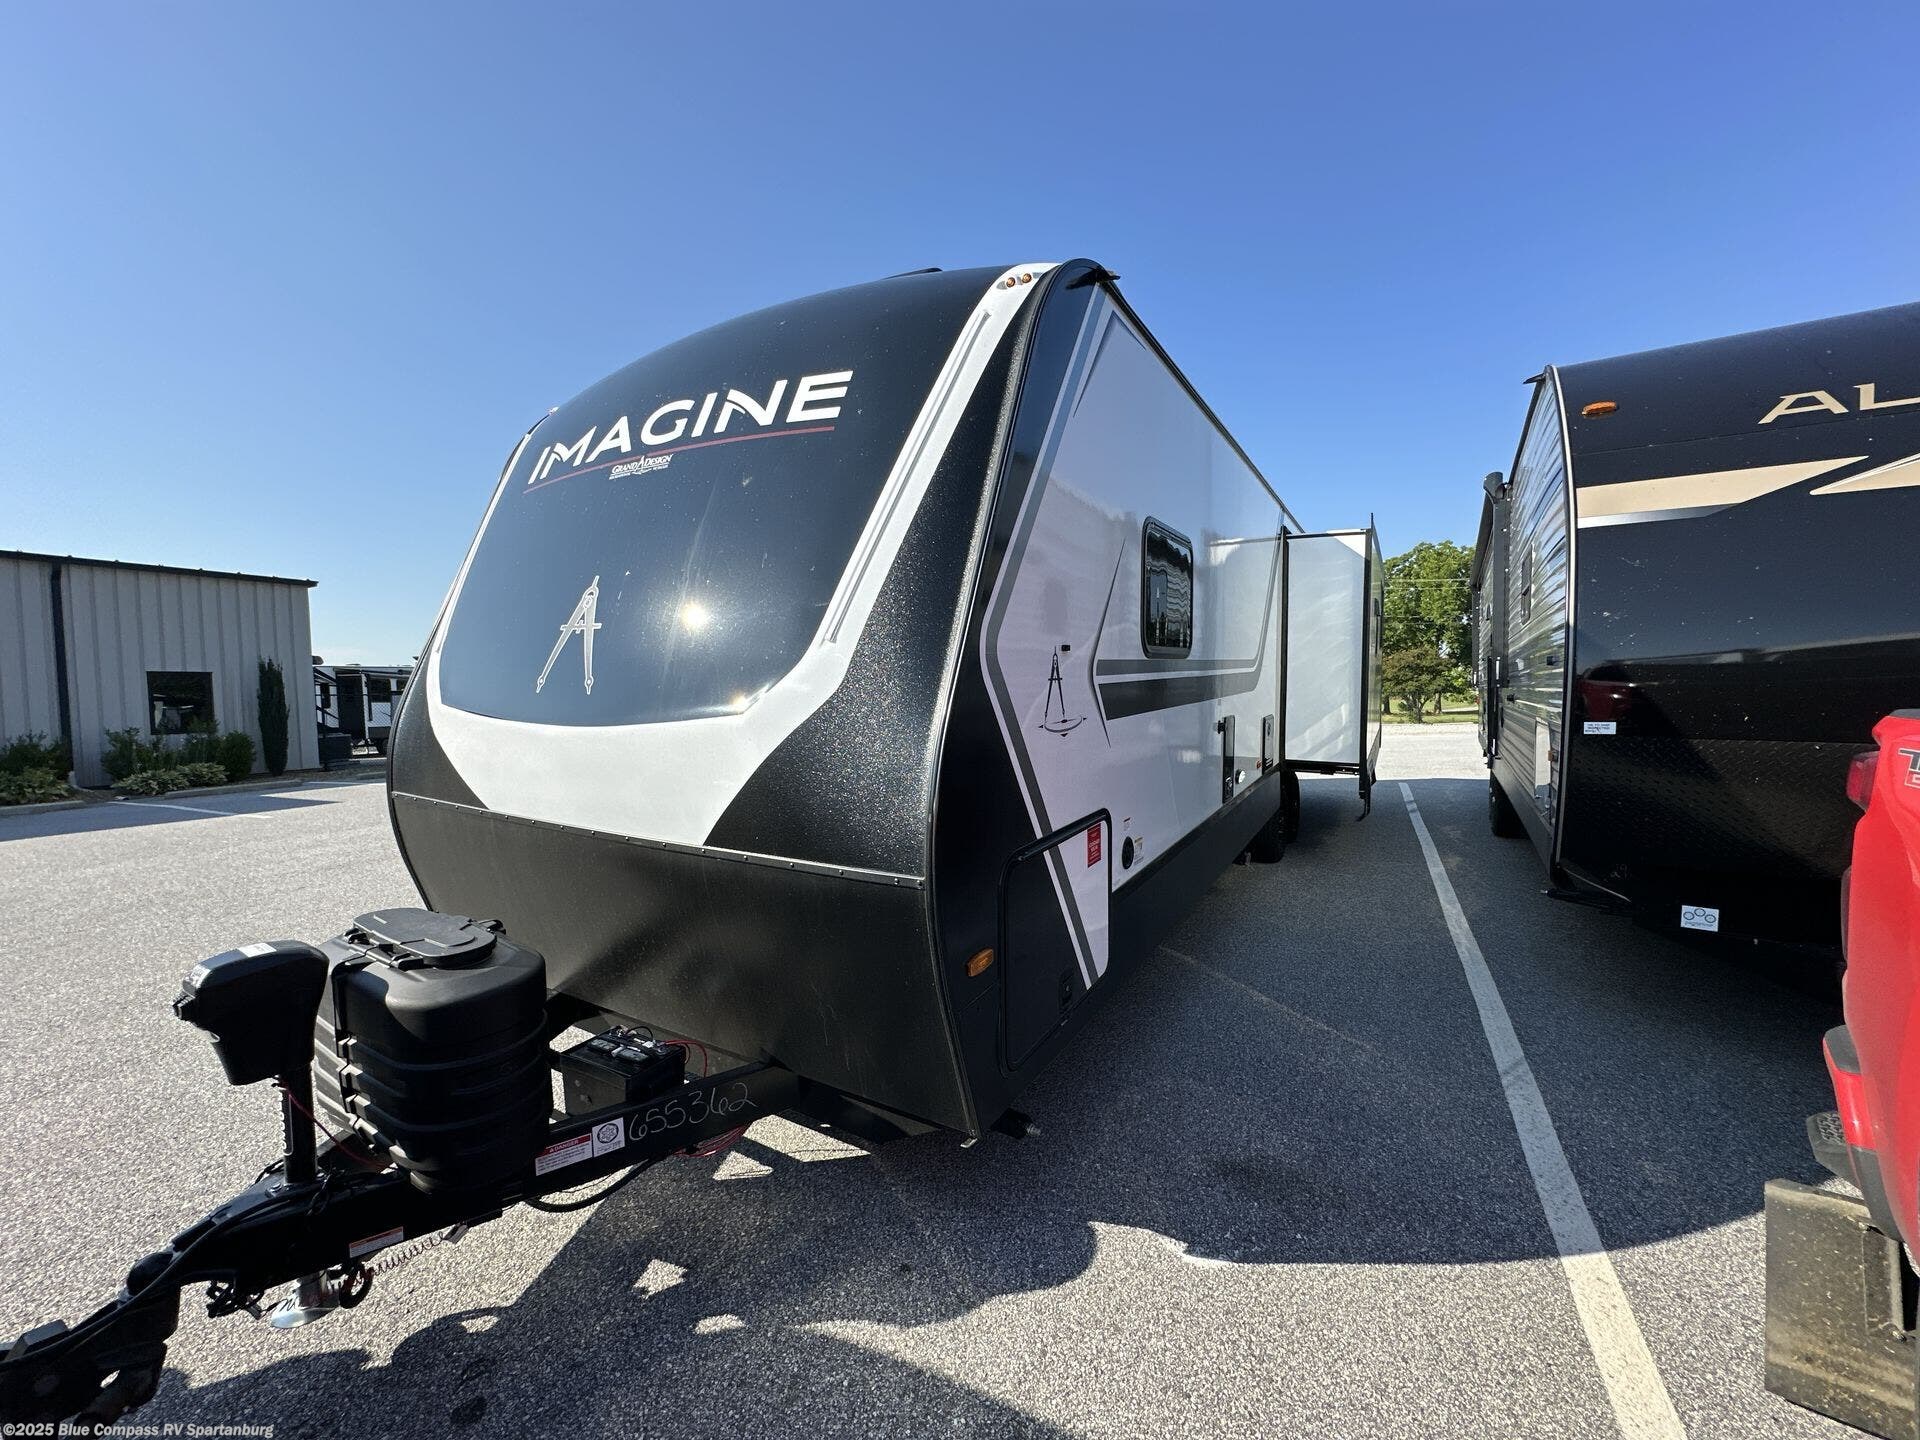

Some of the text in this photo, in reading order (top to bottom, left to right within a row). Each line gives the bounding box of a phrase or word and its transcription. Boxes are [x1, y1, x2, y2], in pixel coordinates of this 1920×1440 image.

[527, 370, 854, 485] IMAGINE
[611, 461, 638, 474] GRAND
[644, 454, 674, 466] DESIGN
[629, 1082, 758, 1141] 655362
[554, 1140, 579, 1152] DANGER
